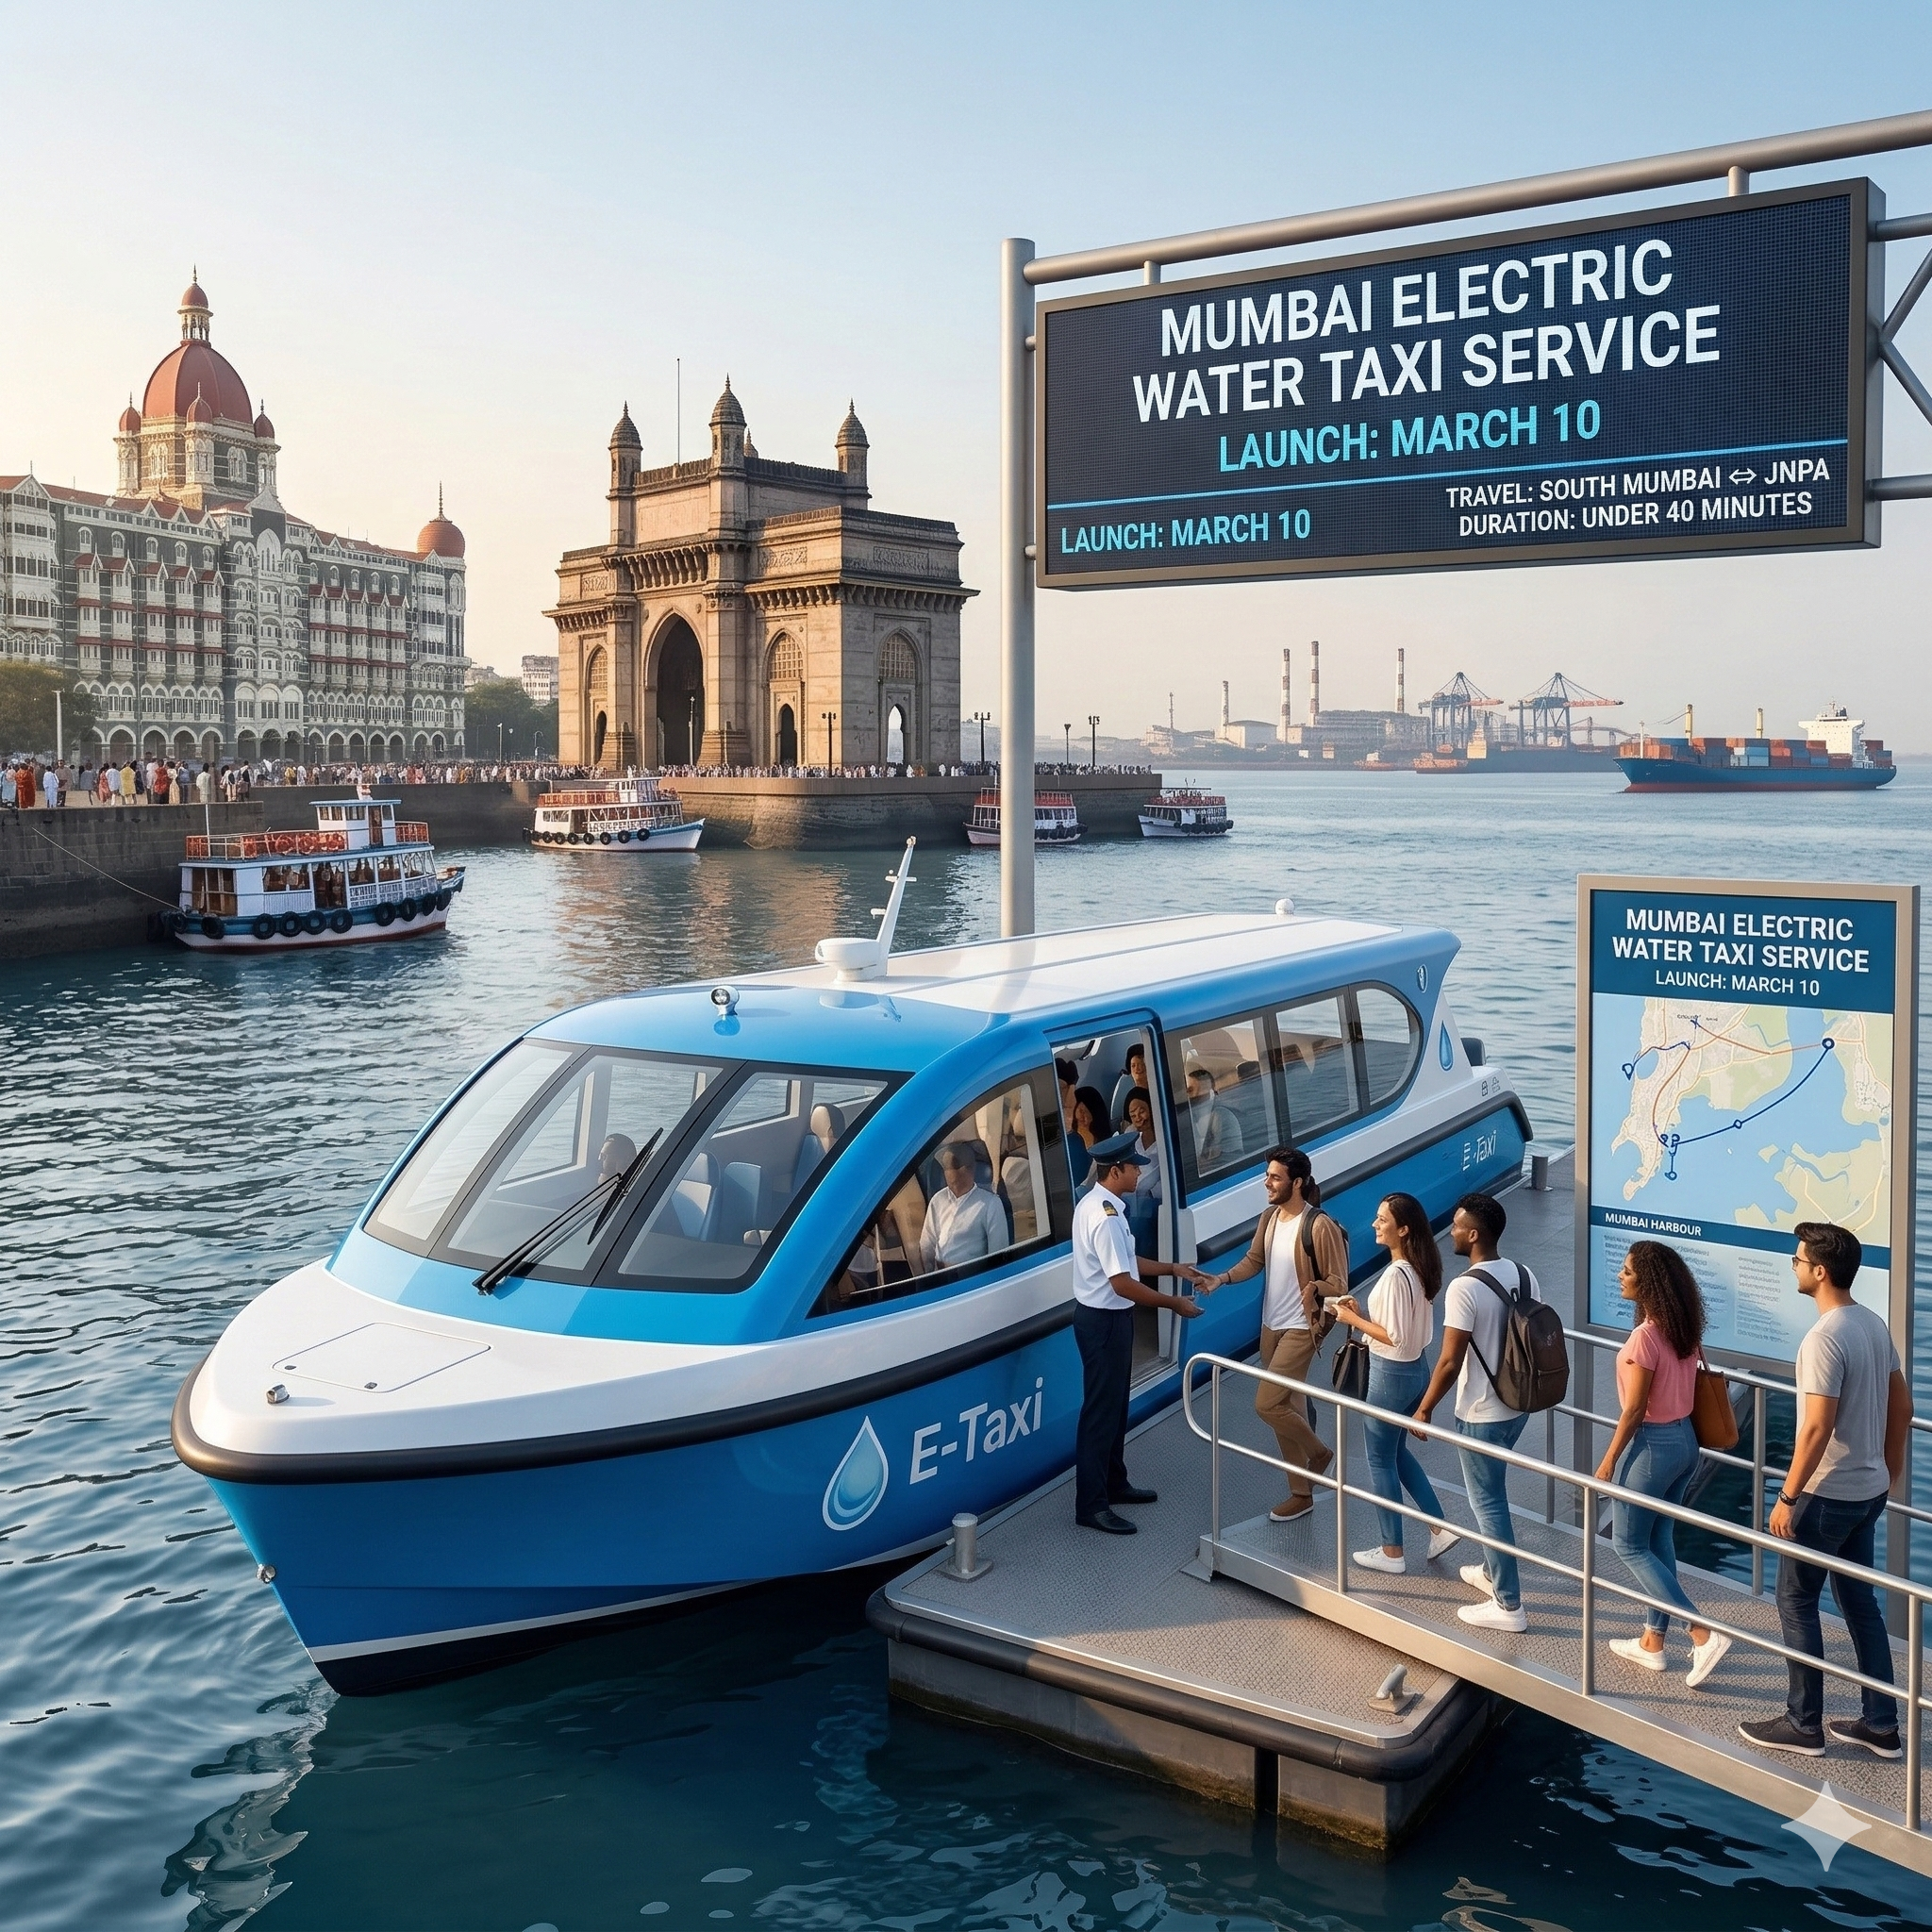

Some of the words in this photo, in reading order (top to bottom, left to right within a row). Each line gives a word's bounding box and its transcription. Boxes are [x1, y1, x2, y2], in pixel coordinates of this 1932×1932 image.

[1161, 281, 1372, 357] MUMBAI
[1392, 240, 1673, 326] ELECTRIC
[1133, 358, 1305, 423] WATER
[1320, 339, 1441, 402] TAXI
[1462, 305, 1721, 388] SERVICE
[1220, 423, 1378, 472] LAUNCH:
[1392, 407, 1537, 457] MARCH
[1553, 400, 1601, 442] 10
[1446, 483, 1533, 508] TRAVEL:
[1540, 475, 1615, 501] SOUTH
[1624, 466, 1721, 495] MUMBAI
[1764, 458, 1830, 485] JNPA
[1062, 523, 1162, 554] LAUNCH:
[1172, 513, 1269, 546] MARCH
[1278, 509, 1310, 541] 10
[1459, 508, 1575, 537] DURATION:
[1583, 502, 1659, 528] UNDER
[1666, 500, 1694, 523] 40
[1702, 491, 1812, 521] MINUTES
[1626, 908, 1724, 935] MUMBAI
[1733, 914, 1854, 941] ELECTRIC
[1612, 937, 1692, 962] WATER
[1699, 941, 1754, 966] TAXI
[1761, 945, 1870, 973] SERVICE
[1656, 970, 1726, 991] LAUNCH:
[1732, 975, 1793, 994] MARCH
[1799, 979, 1820, 996] 10
[1605, 1212, 1648, 1229] MUMBAI
[1651, 1220, 1702, 1237] HARBOUR
[909, 1376, 1043, 1485] E-Taxi
